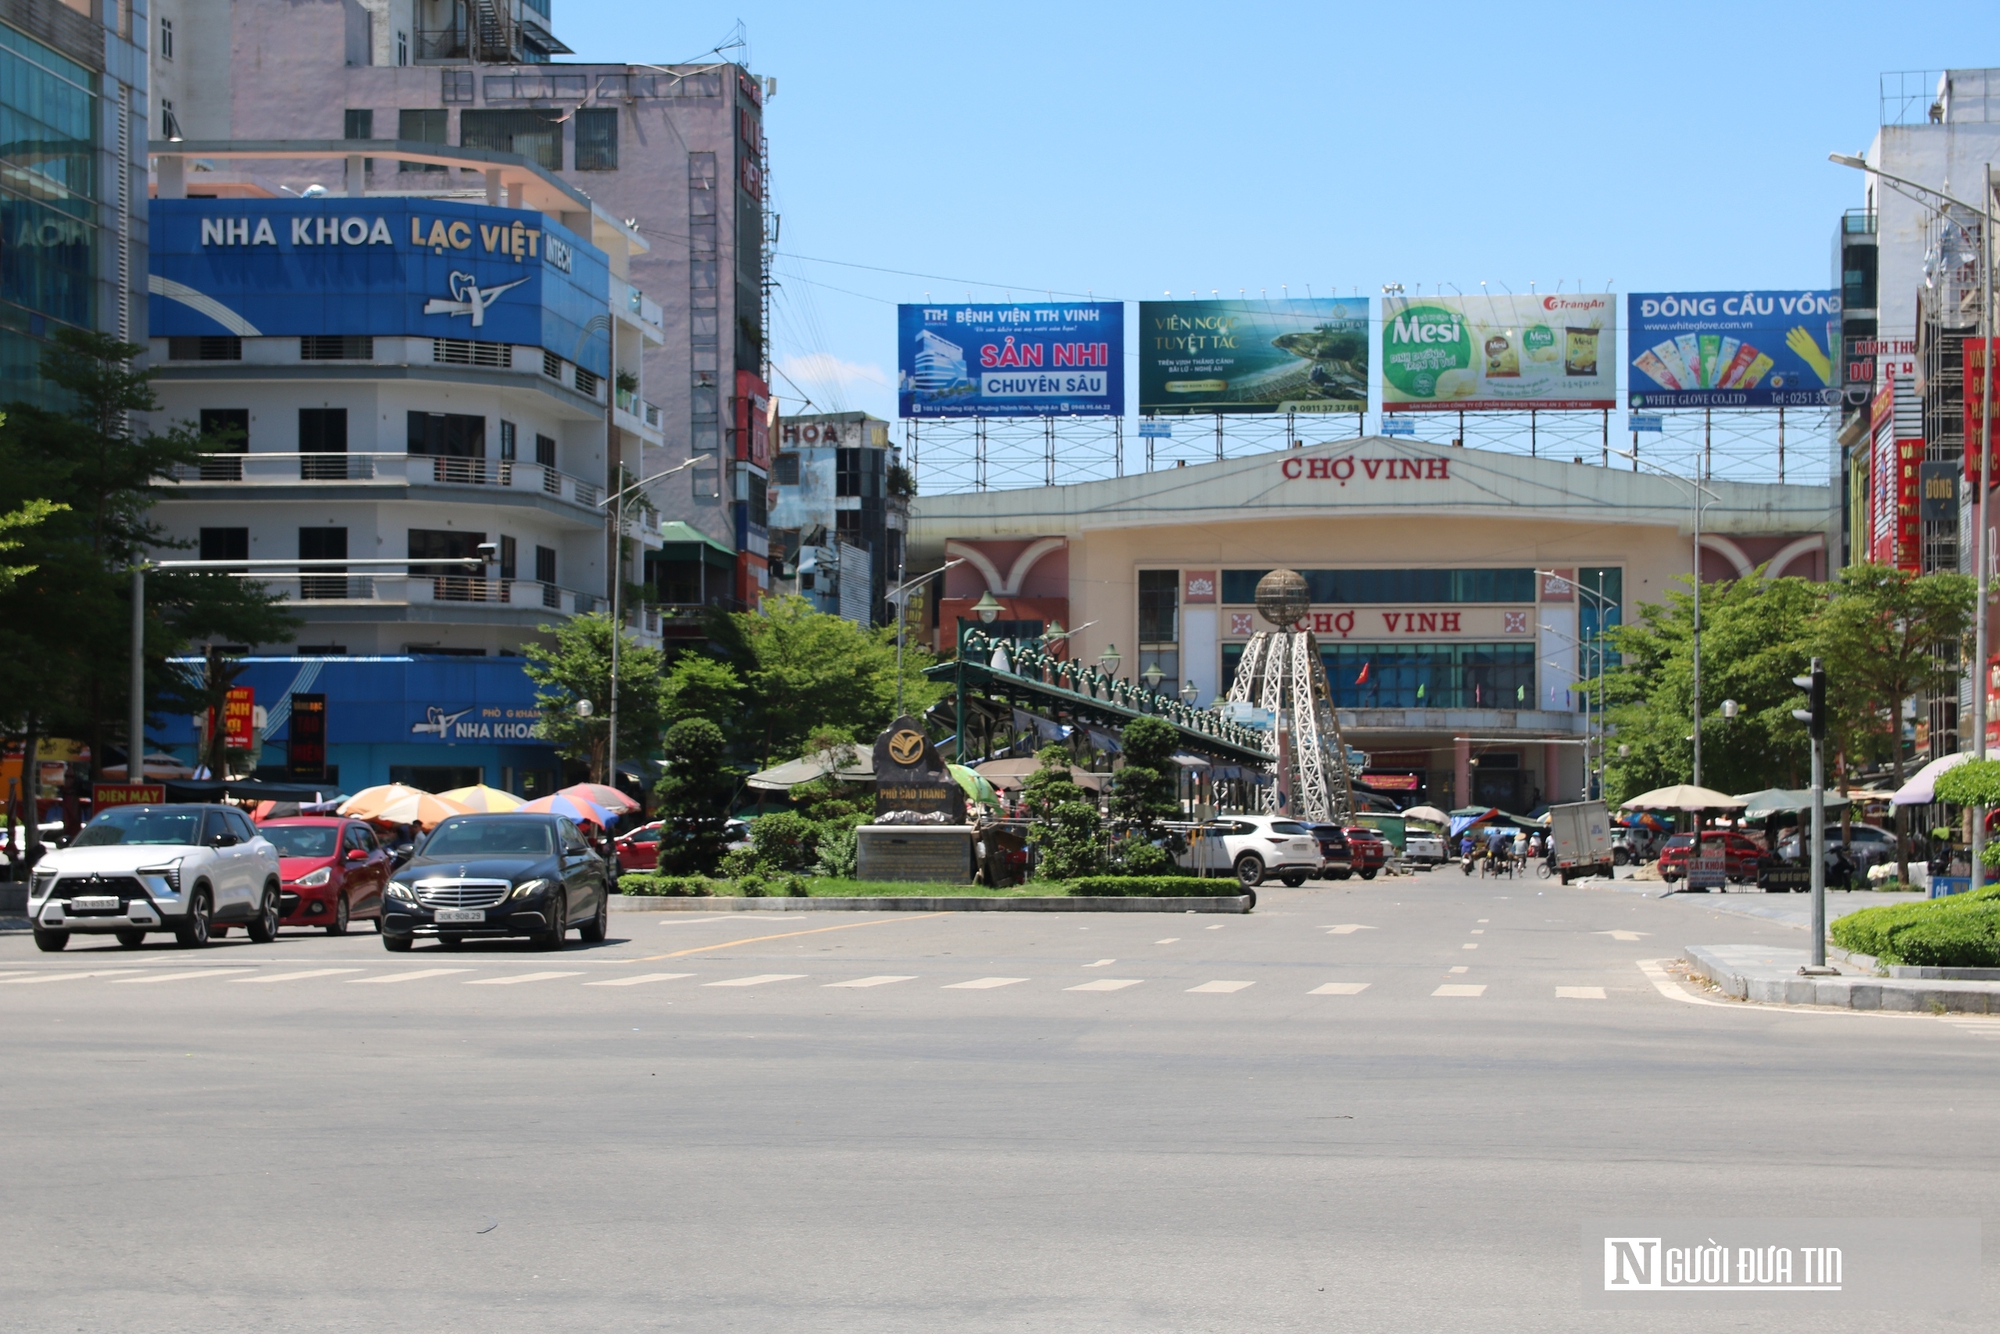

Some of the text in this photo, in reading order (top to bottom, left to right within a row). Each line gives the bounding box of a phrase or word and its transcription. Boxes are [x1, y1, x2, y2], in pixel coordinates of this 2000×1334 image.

[202, 217, 394, 246] NHA KHOA
[411, 216, 541, 262] LẠC VIỆT
[545, 233, 573, 275] INTECH
[1560, 299, 1605, 311] TrangAn
[1641, 295, 1717, 318] ĐÔNG
[1722, 292, 1774, 316] CẦU
[923, 309, 948, 321] TTH
[956, 307, 1100, 326] BỆNH VIỆN TTH VINH
[1154, 314, 1191, 330] VIÊN
[1392, 313, 1461, 344] Mesi
[1529, 331, 1551, 341] Mesi
[1644, 321, 1753, 332] www.whiteglove.com.vn
[980, 335, 1108, 367] SẢN NHI
[1855, 336, 1888, 355] KÍNH
[987, 375, 1101, 394] CHUYÊN SÂU
[1645, 394, 1677, 405] WHITE
[1678, 394, 1709, 405] GLOVE
[1790, 392, 1812, 404] 0251
[1335, 404, 1346, 412] 37
[1347, 404, 1359, 412] 68
[1282, 455, 1451, 487] CHỢ VINH
[1294, 610, 1461, 638] CHỢ VINH
[456, 722, 490, 738] NHA
[900, 788, 917, 800] CAO
